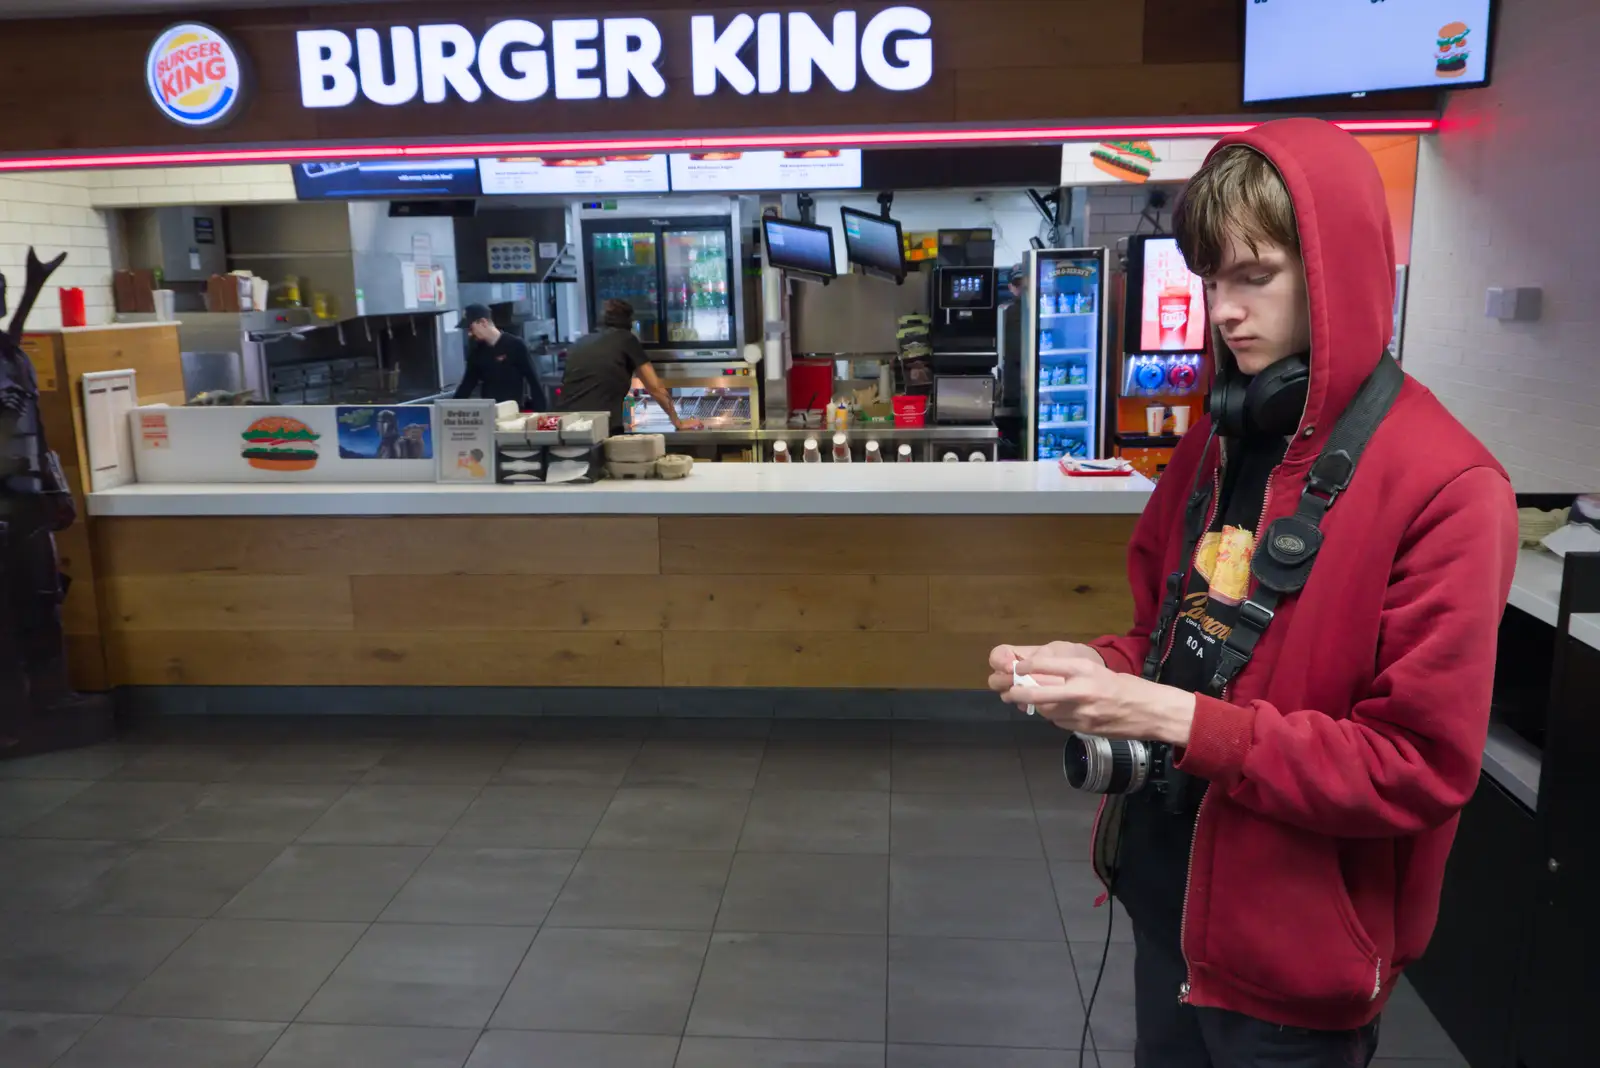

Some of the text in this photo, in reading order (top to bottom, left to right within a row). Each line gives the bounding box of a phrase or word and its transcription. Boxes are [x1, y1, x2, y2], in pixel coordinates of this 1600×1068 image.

[157, 41, 221, 78] BURGER
[161, 57, 226, 104] KING
[296, 6, 933, 108] BURGER KING
